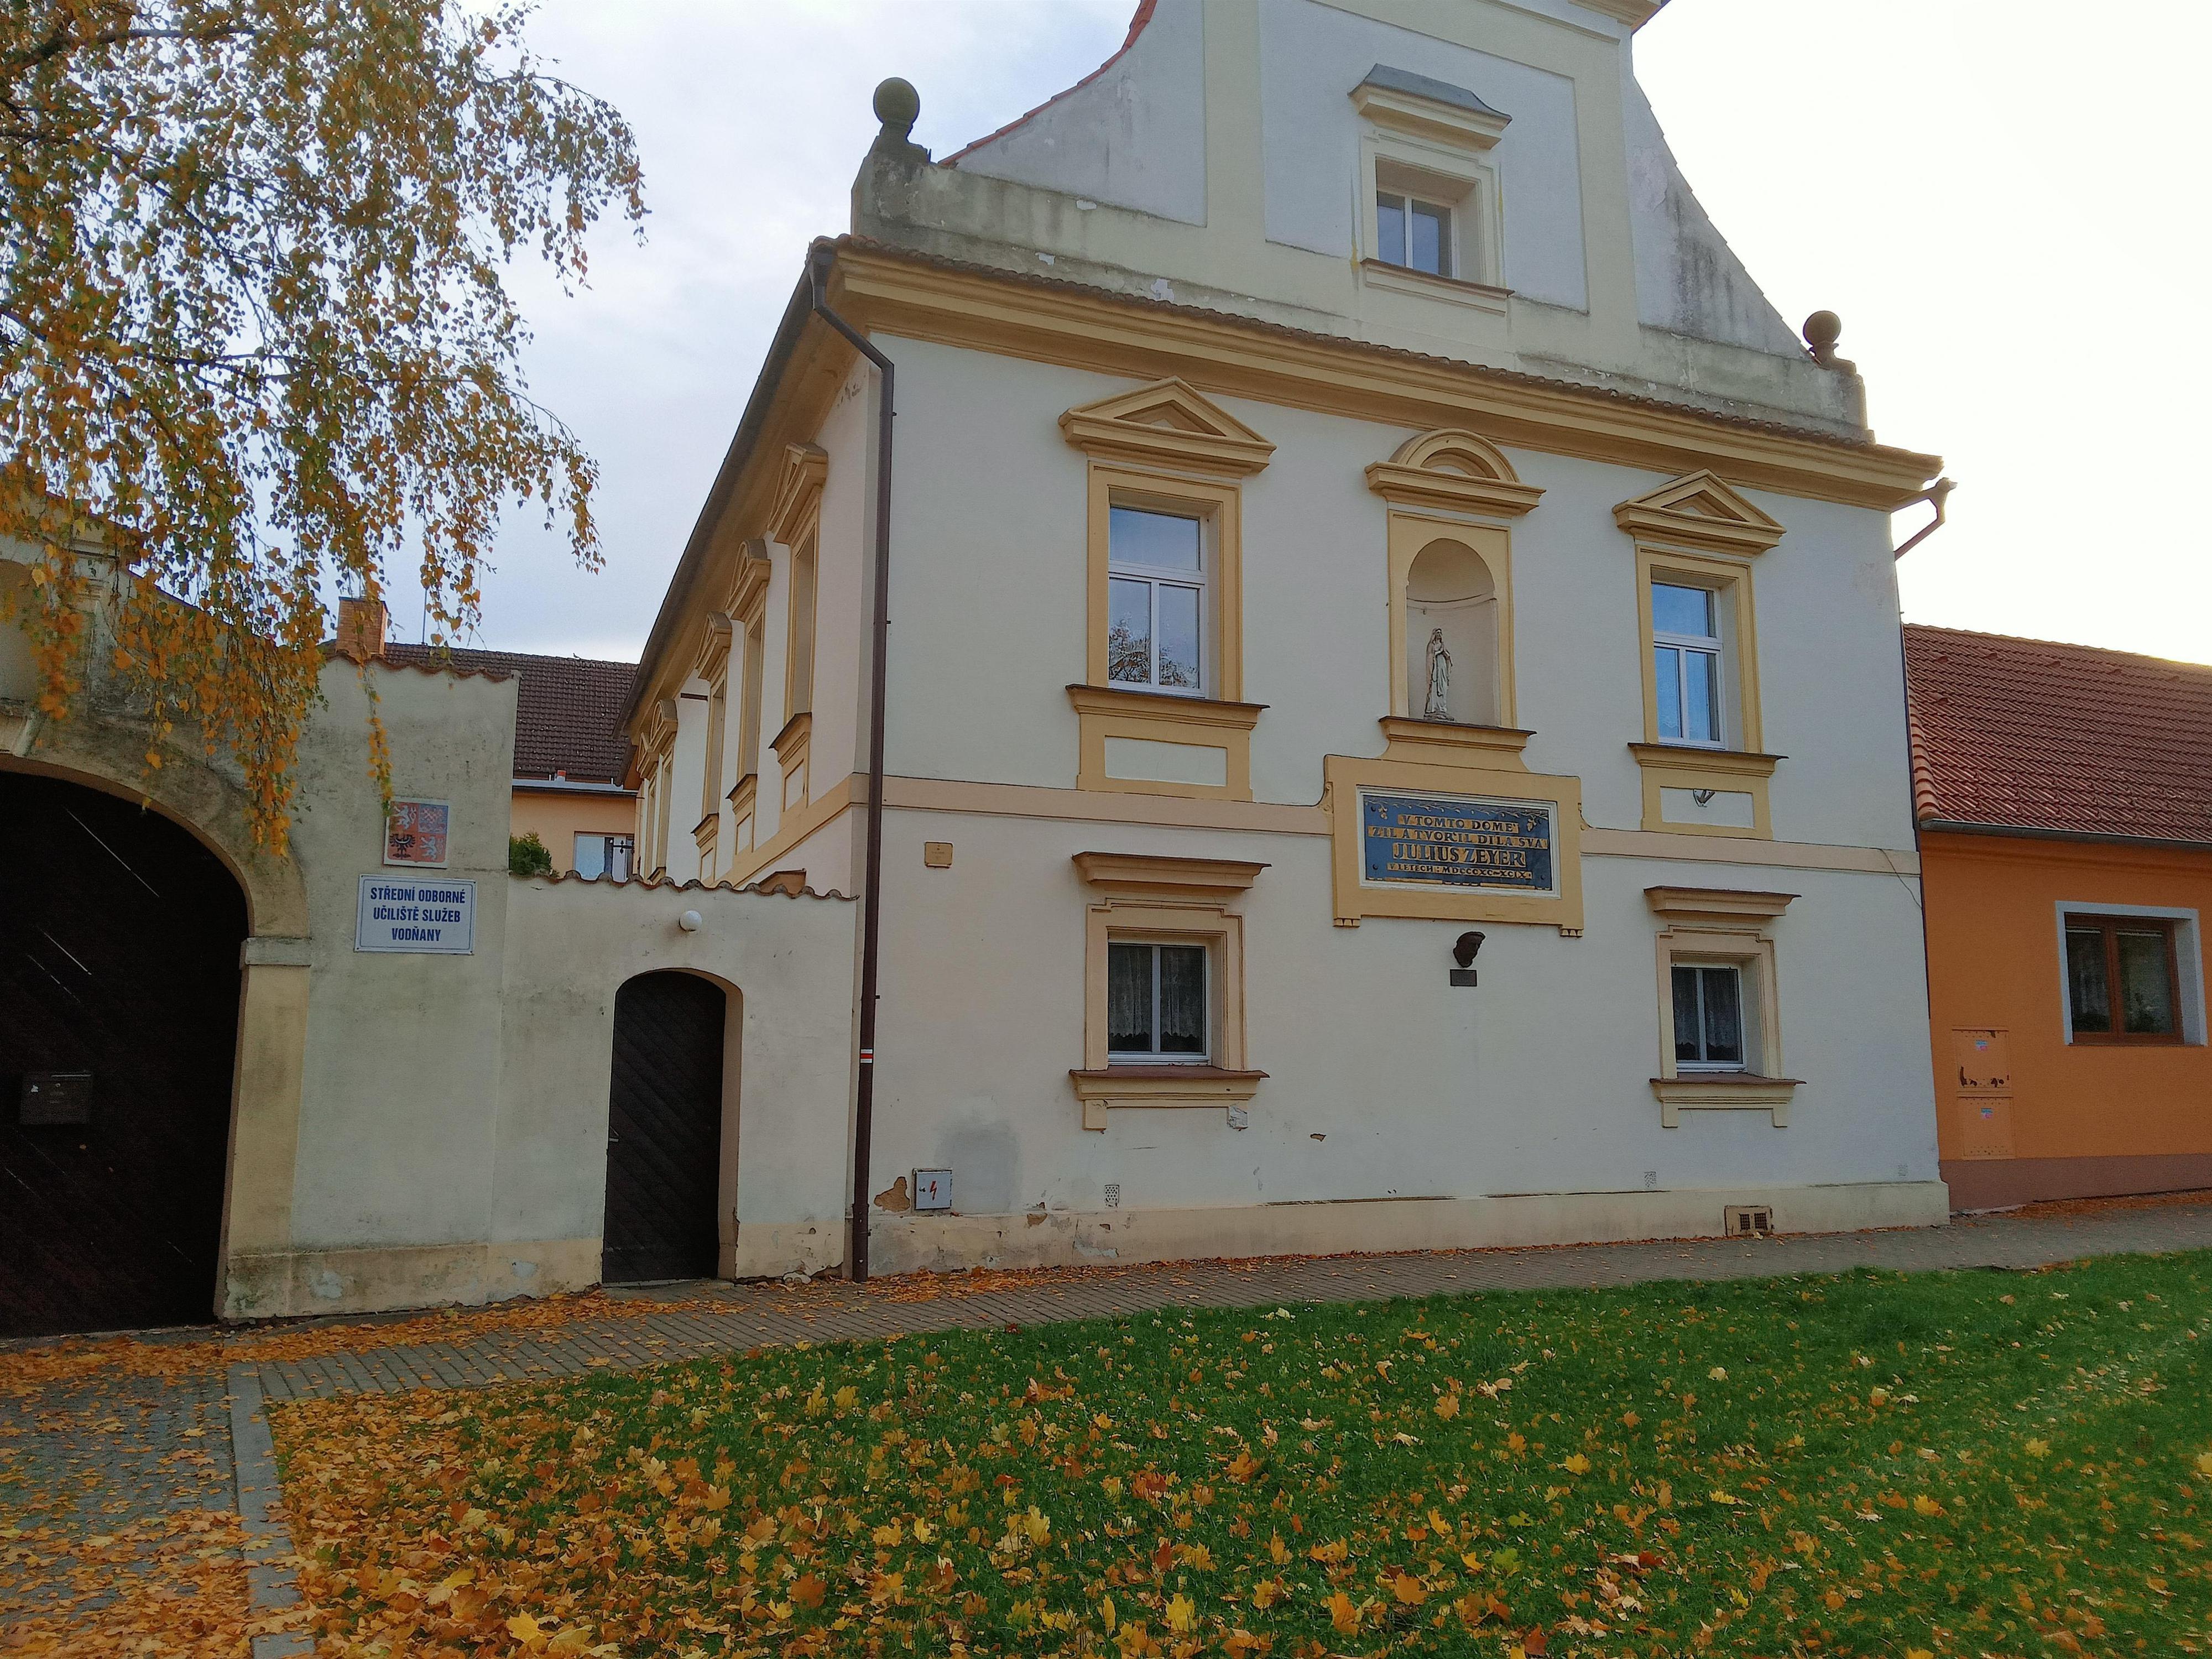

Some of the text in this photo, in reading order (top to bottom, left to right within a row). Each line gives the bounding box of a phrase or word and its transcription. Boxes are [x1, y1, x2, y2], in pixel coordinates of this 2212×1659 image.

[1402, 815, 1410, 824] V
[1415, 816, 1465, 828] TOMTO
[1402, 828, 1410, 839] A
[1394, 843, 1525, 867] JULIUS ZEYER
[371, 886, 466, 904] STŘEDNÍ ODBORNÉ
[373, 905, 461, 922] UČILIŠTĚ SLUŽEB
[392, 926, 441, 941] VODŇANY
